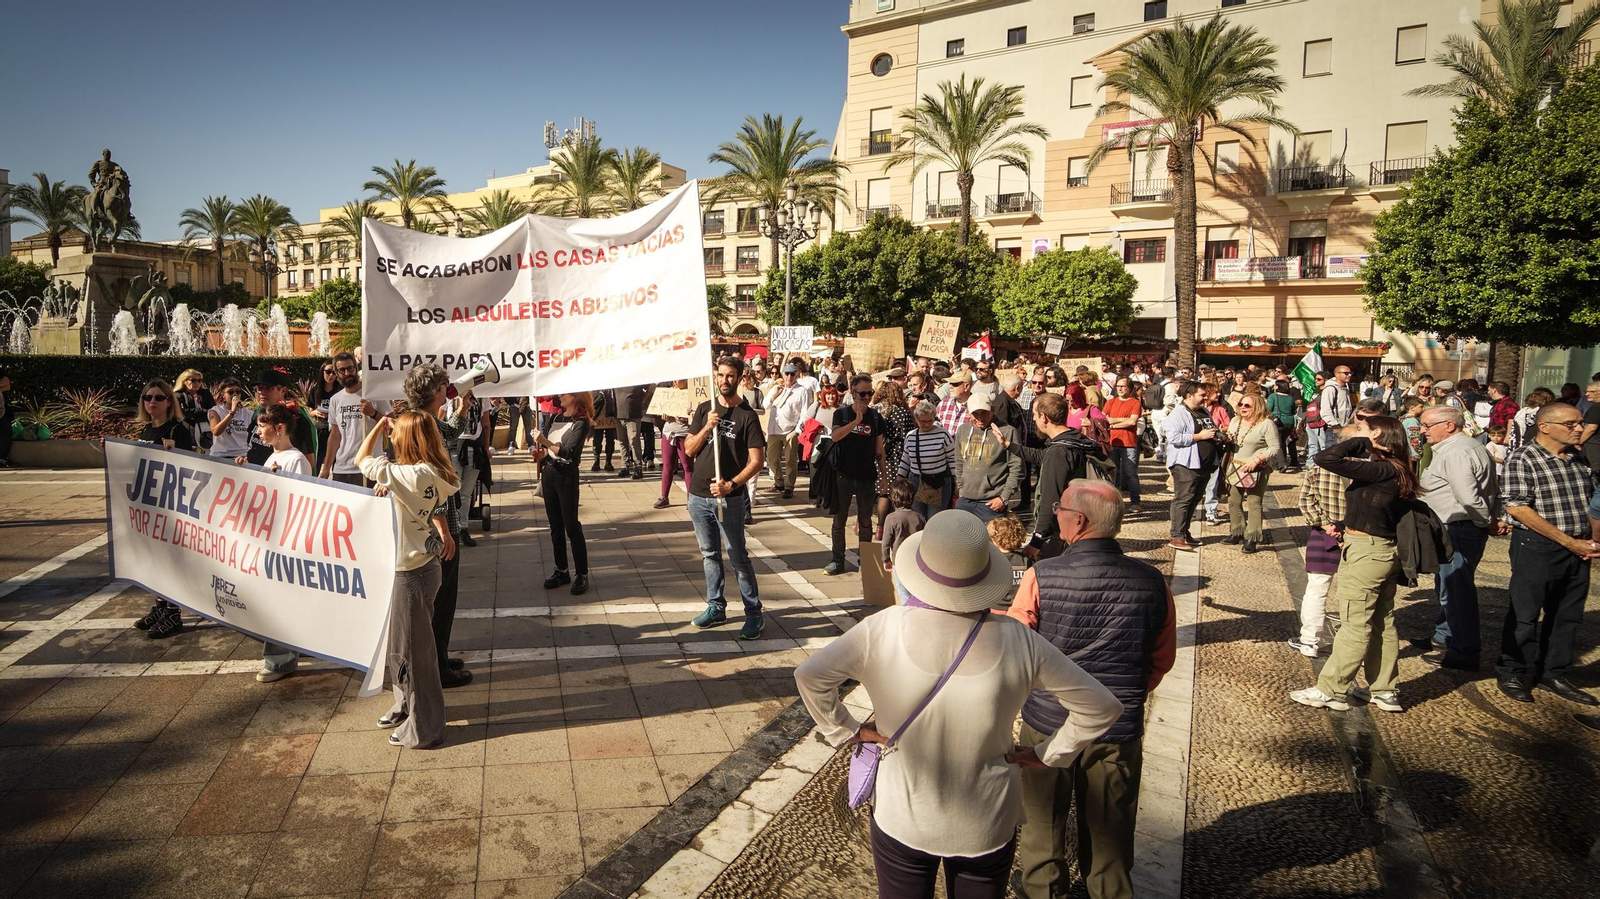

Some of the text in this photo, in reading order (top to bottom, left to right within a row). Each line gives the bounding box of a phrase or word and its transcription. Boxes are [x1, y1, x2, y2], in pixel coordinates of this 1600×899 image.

[376, 256, 397, 277] SE
[402, 253, 512, 279] ACABARON
[554, 245, 620, 267] CASAS
[407, 307, 446, 325] LOS
[569, 283, 659, 317] ABUSIVOS
[926, 326, 954, 338] AIRBNB
[935, 320, 949, 329] TU
[929, 336, 946, 345] ERA
[930, 344, 949, 354] CASA
[368, 354, 393, 371] LA
[400, 354, 437, 371] PAZ
[443, 352, 493, 370] PAR
[501, 352, 535, 370] LOS
[126, 458, 357, 561] JEREZ PARA VIVIR
[129, 506, 367, 599] POR EL DERECHO A LA VIVIENDA
[210, 574, 238, 598] JEREZ
